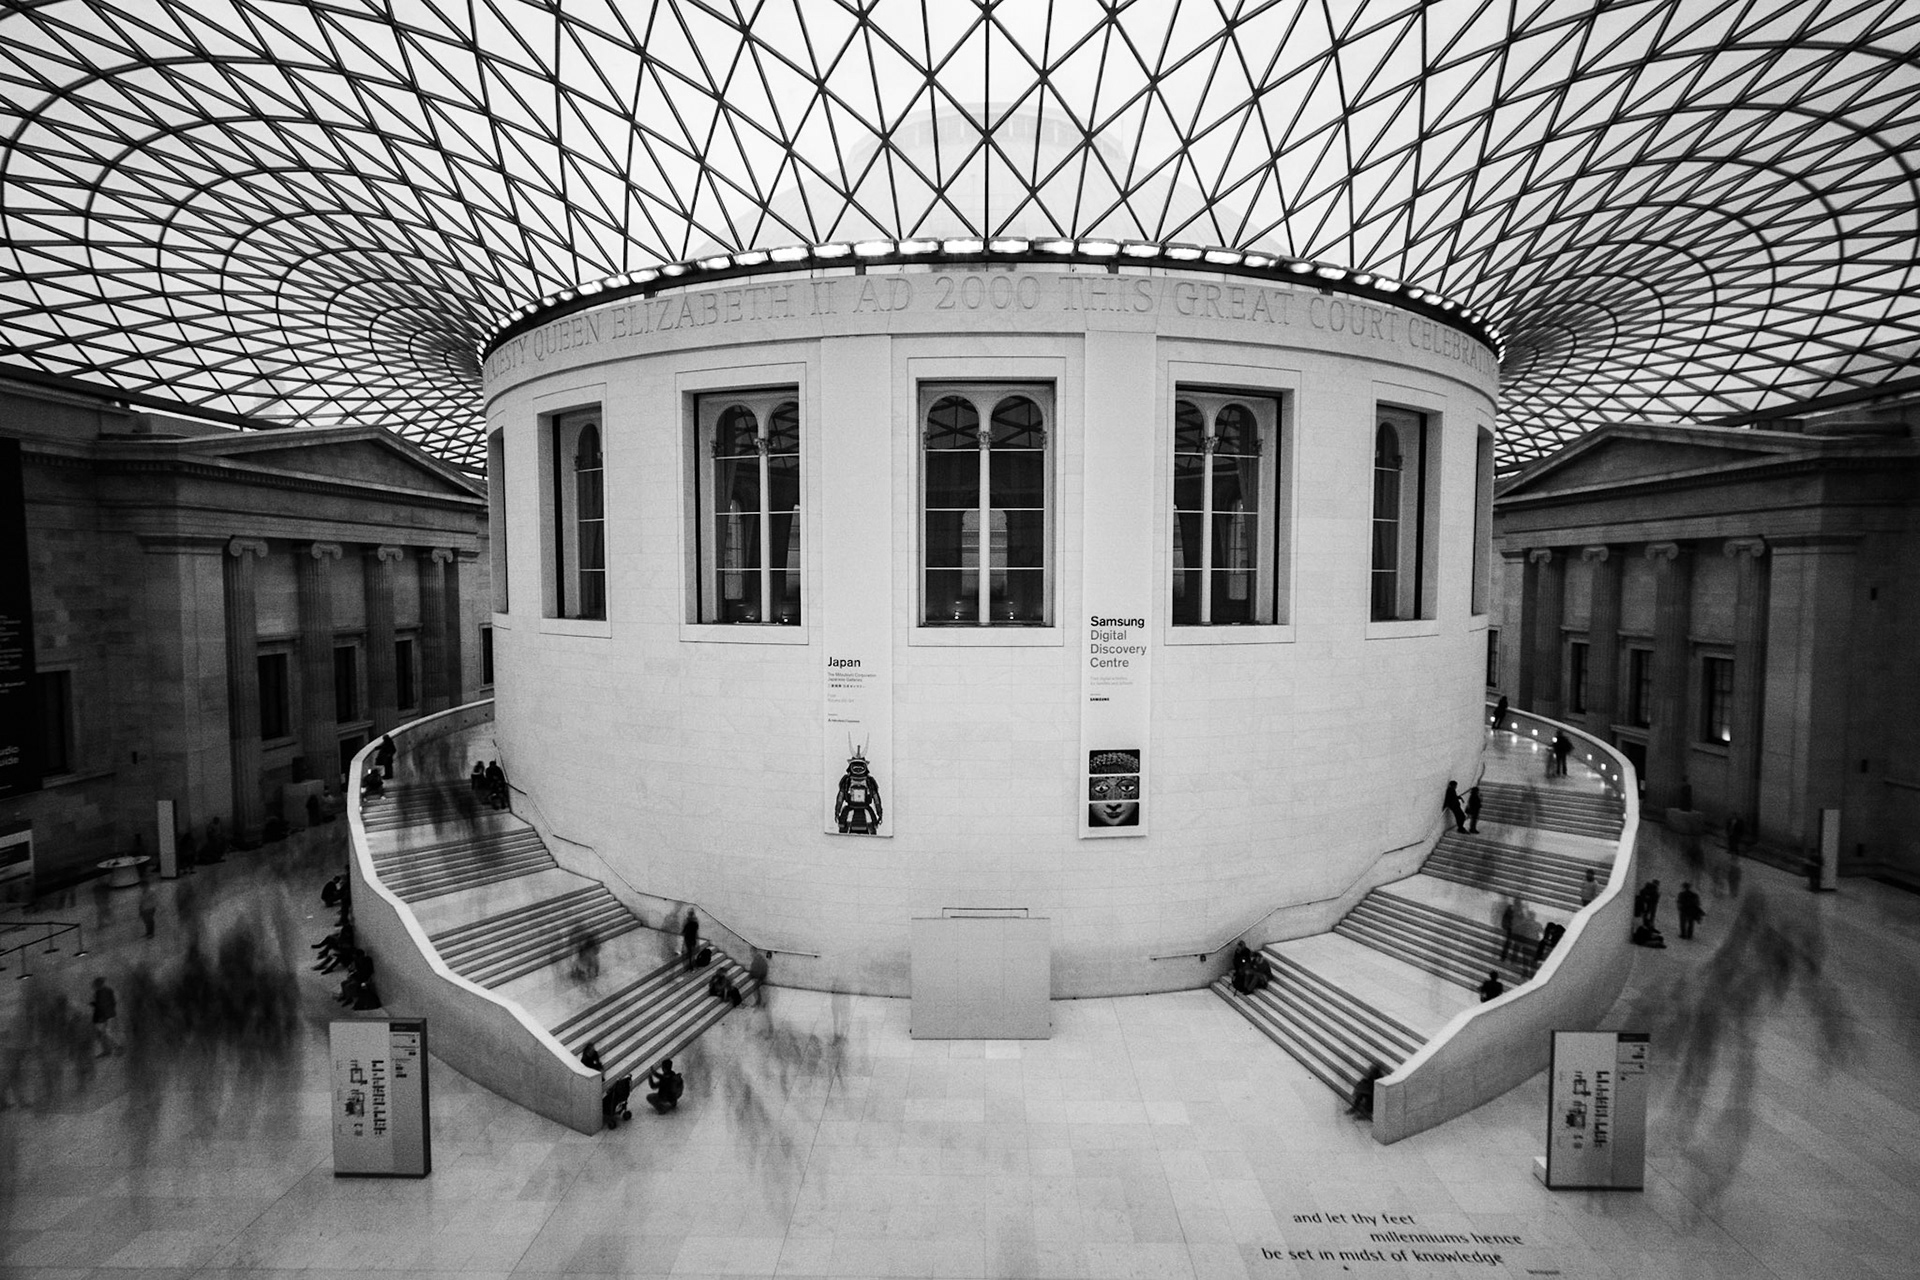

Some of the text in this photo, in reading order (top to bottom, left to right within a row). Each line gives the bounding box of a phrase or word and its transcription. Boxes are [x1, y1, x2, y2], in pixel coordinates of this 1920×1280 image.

[534, 312, 601, 361] QUEEN
[612, 284, 795, 340] ELIZABETH
[811, 280, 837, 315] II
[853, 278, 913, 312] AD
[935, 276, 1041, 310] 2000
[1059, 277, 1154, 312] THIS
[1174, 281, 1294, 325] GREAT
[1310, 297, 1398, 342] COURT
[1090, 616, 1145, 628] Samsung
[1090, 629, 1127, 643] Digital
[1090, 643, 1147, 656] Discovery
[828, 656, 861, 669] Japan
[1090, 657, 1129, 668] Centre
[1293, 1212, 1416, 1226] and let thy feet
[1370, 1231, 1524, 1245] millenniums hence
[1261, 1248, 1504, 1267] be set in midst of knowledge
